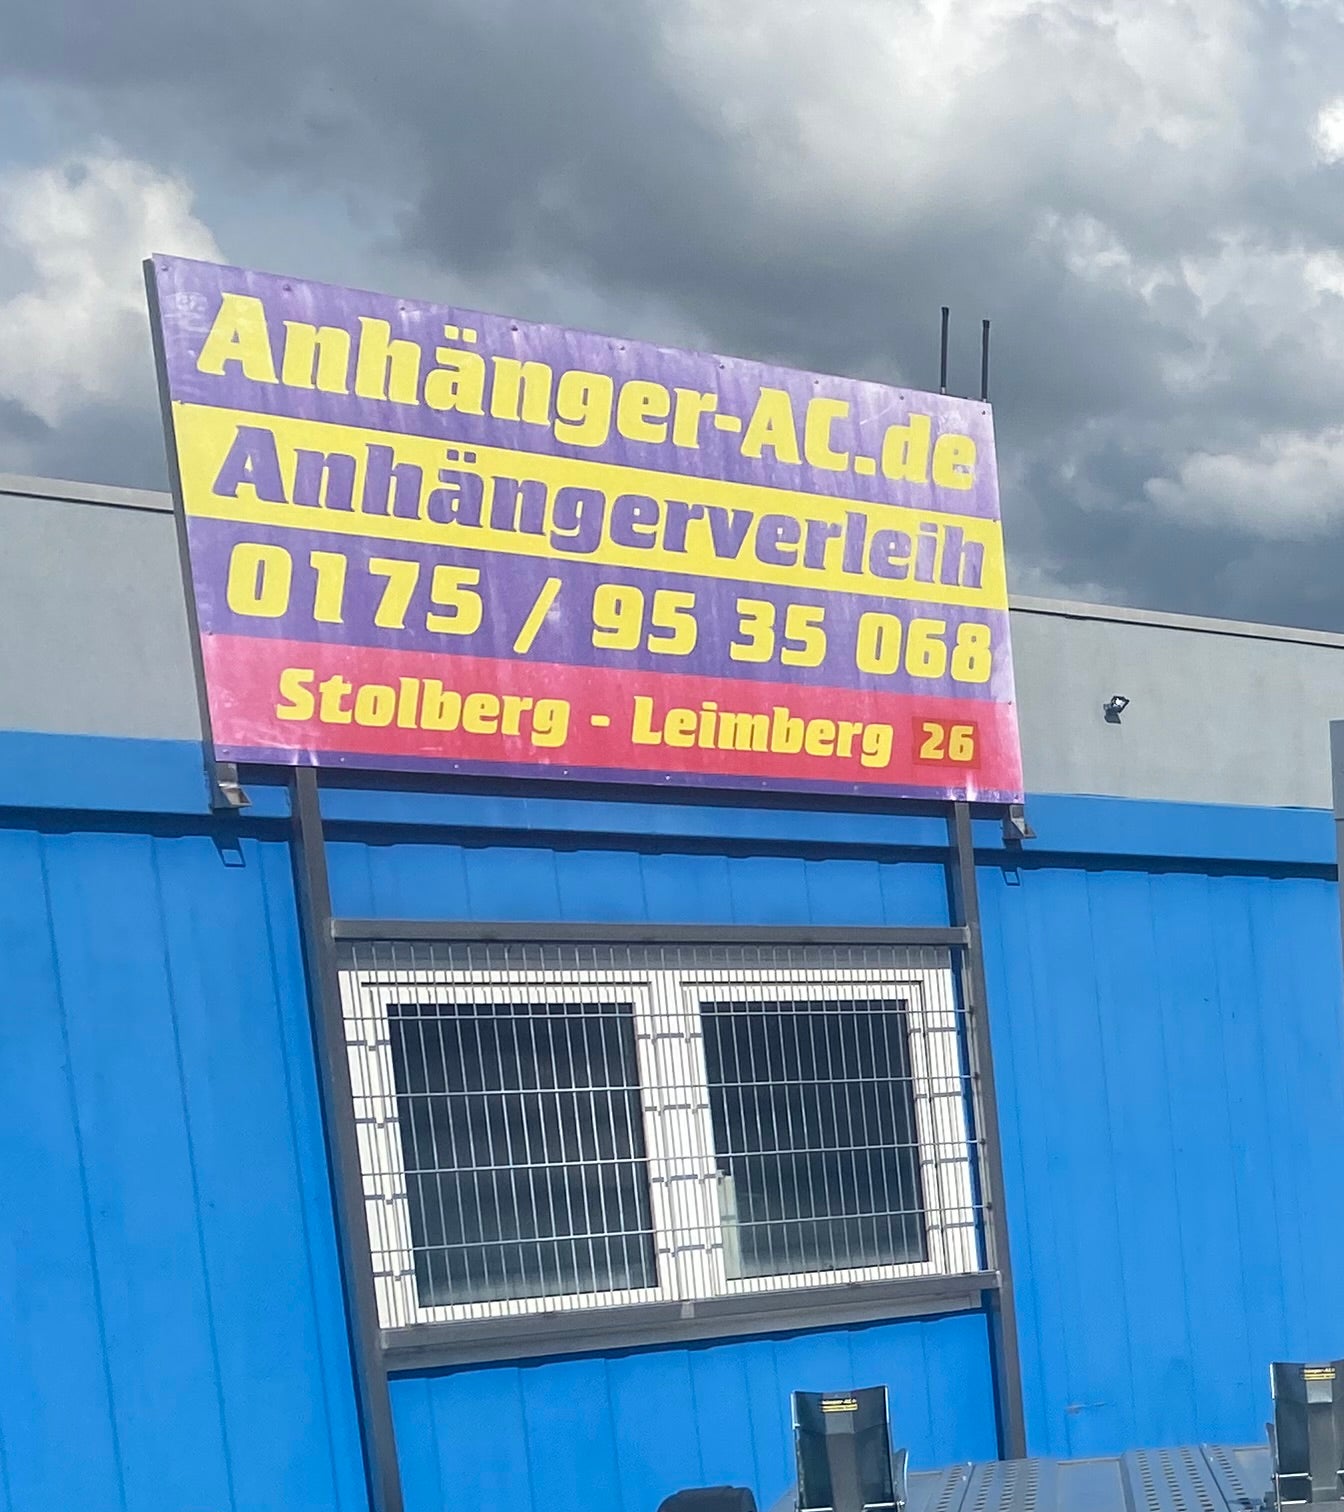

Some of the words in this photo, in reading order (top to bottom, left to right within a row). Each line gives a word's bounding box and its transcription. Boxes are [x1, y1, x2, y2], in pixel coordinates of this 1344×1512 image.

[196, 292, 977, 491] Anhänger-AC.de
[212, 425, 984, 589] Anhängerverleih
[226, 542, 483, 635] 0175
[513, 577, 562, 654] /
[592, 584, 697, 656] 95
[730, 598, 827, 668] 35
[856, 612, 992, 683] 068
[275, 668, 571, 748] Stolberg
[631, 696, 894, 768] Leimberg
[919, 722, 974, 762] 26
